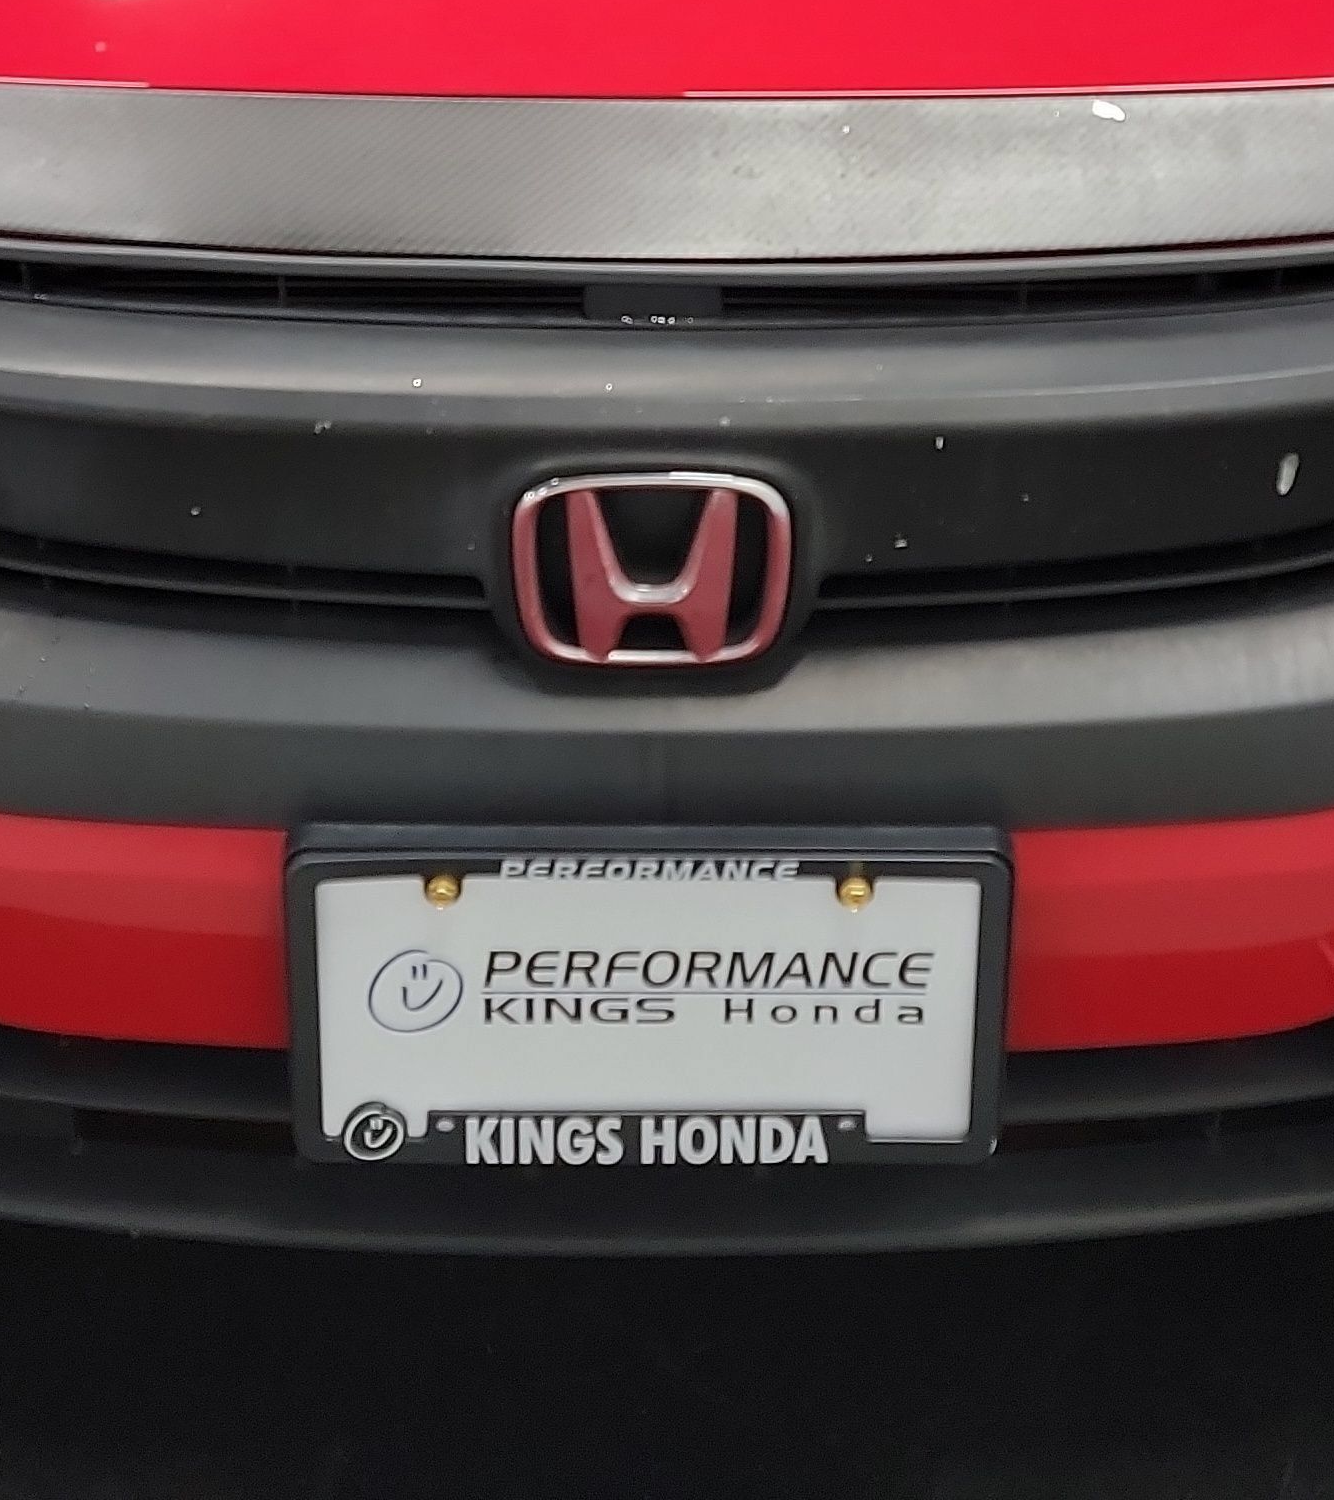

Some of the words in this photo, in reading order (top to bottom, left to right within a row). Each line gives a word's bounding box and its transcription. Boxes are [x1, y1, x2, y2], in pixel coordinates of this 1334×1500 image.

[500, 858, 800, 882] PERFORMANCE
[484, 950, 935, 988] PERFORMANCE
[484, 998, 676, 1024] KINGS
[724, 998, 925, 1024] Honda
[466, 1116, 623, 1165] KINGS
[640, 1115, 830, 1164] HONDA
